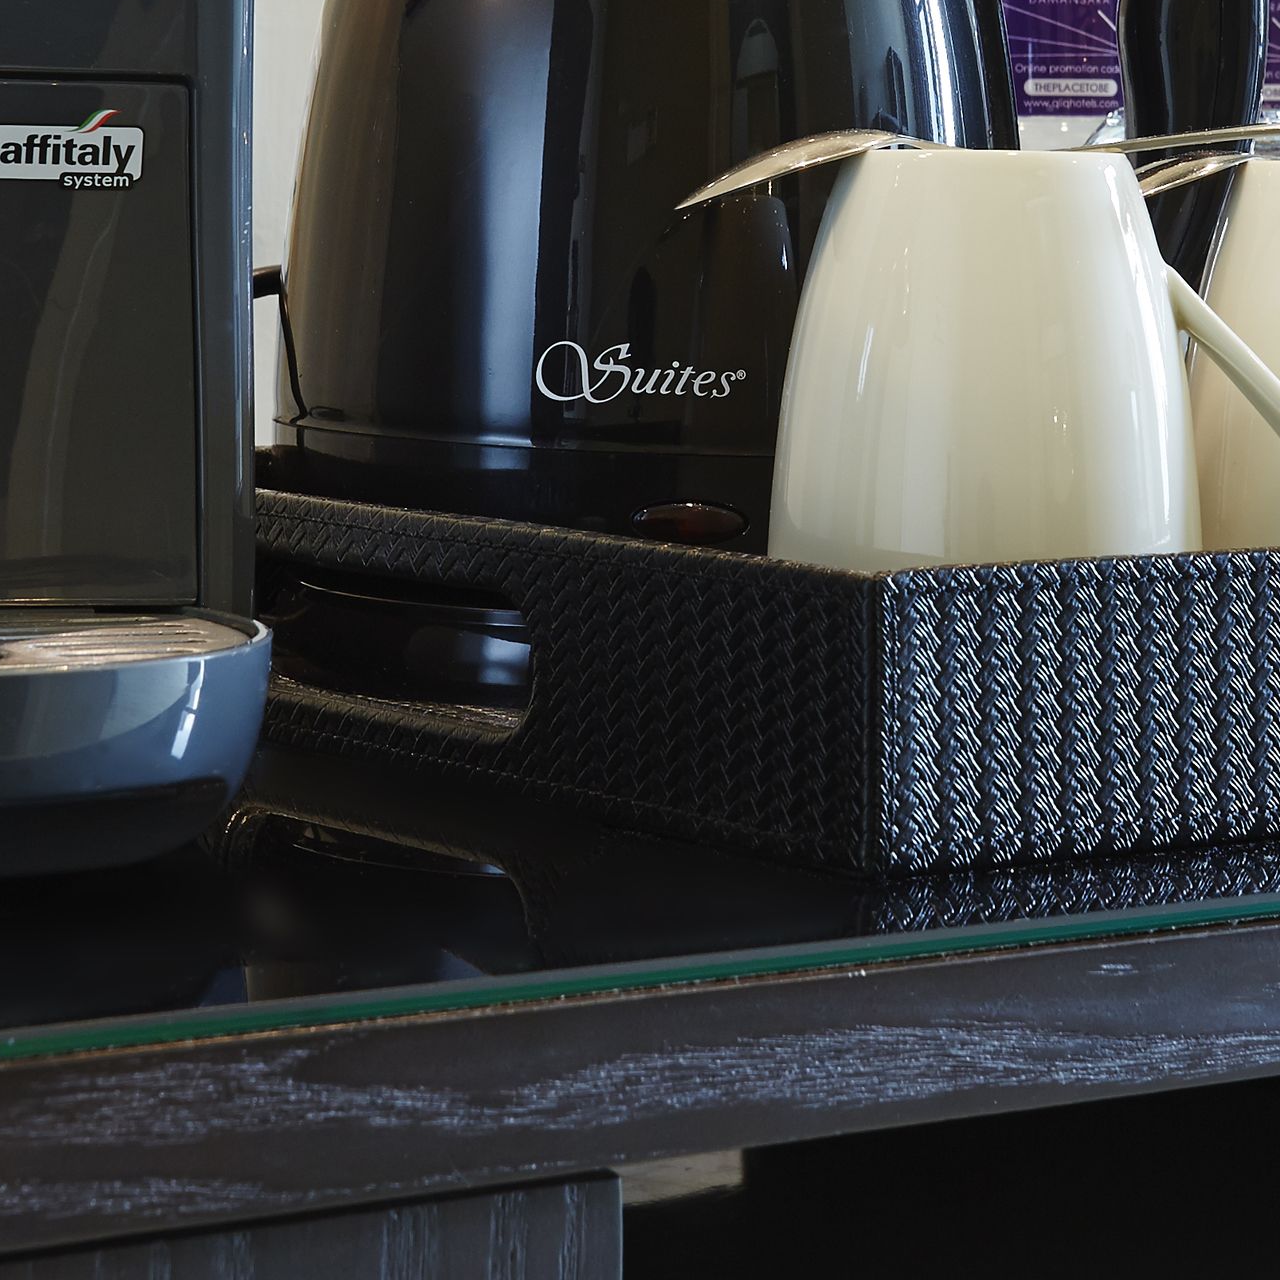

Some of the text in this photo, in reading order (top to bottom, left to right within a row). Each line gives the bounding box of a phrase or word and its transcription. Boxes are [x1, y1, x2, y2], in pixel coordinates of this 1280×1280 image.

[1049, 63, 1099, 77] promotion
[1033, 82, 1110, 94] THEPLACETOBE
[1023, 98, 1120, 111] www.qliqhotels.com
[63, 174, 130, 190] system
